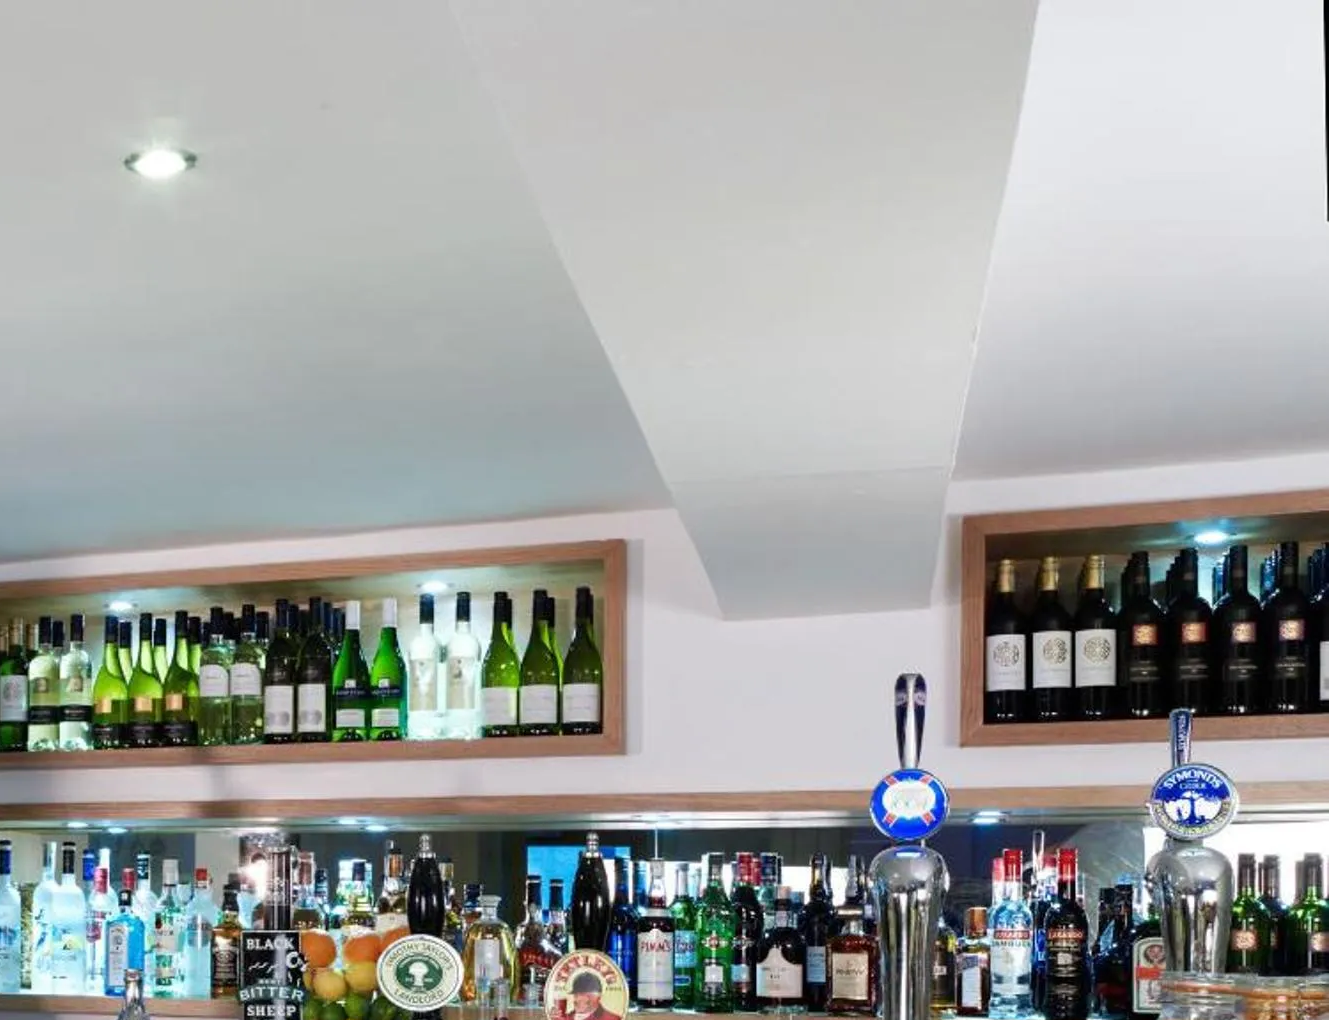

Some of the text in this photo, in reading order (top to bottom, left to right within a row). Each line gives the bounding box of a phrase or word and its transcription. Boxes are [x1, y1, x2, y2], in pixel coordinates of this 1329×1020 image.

[1163, 768, 1224, 789] SYMONDS
[246, 938, 295, 951] BLACK
[239, 985, 305, 1002] BITTER
[246, 1004, 297, 1017] SHEEP
